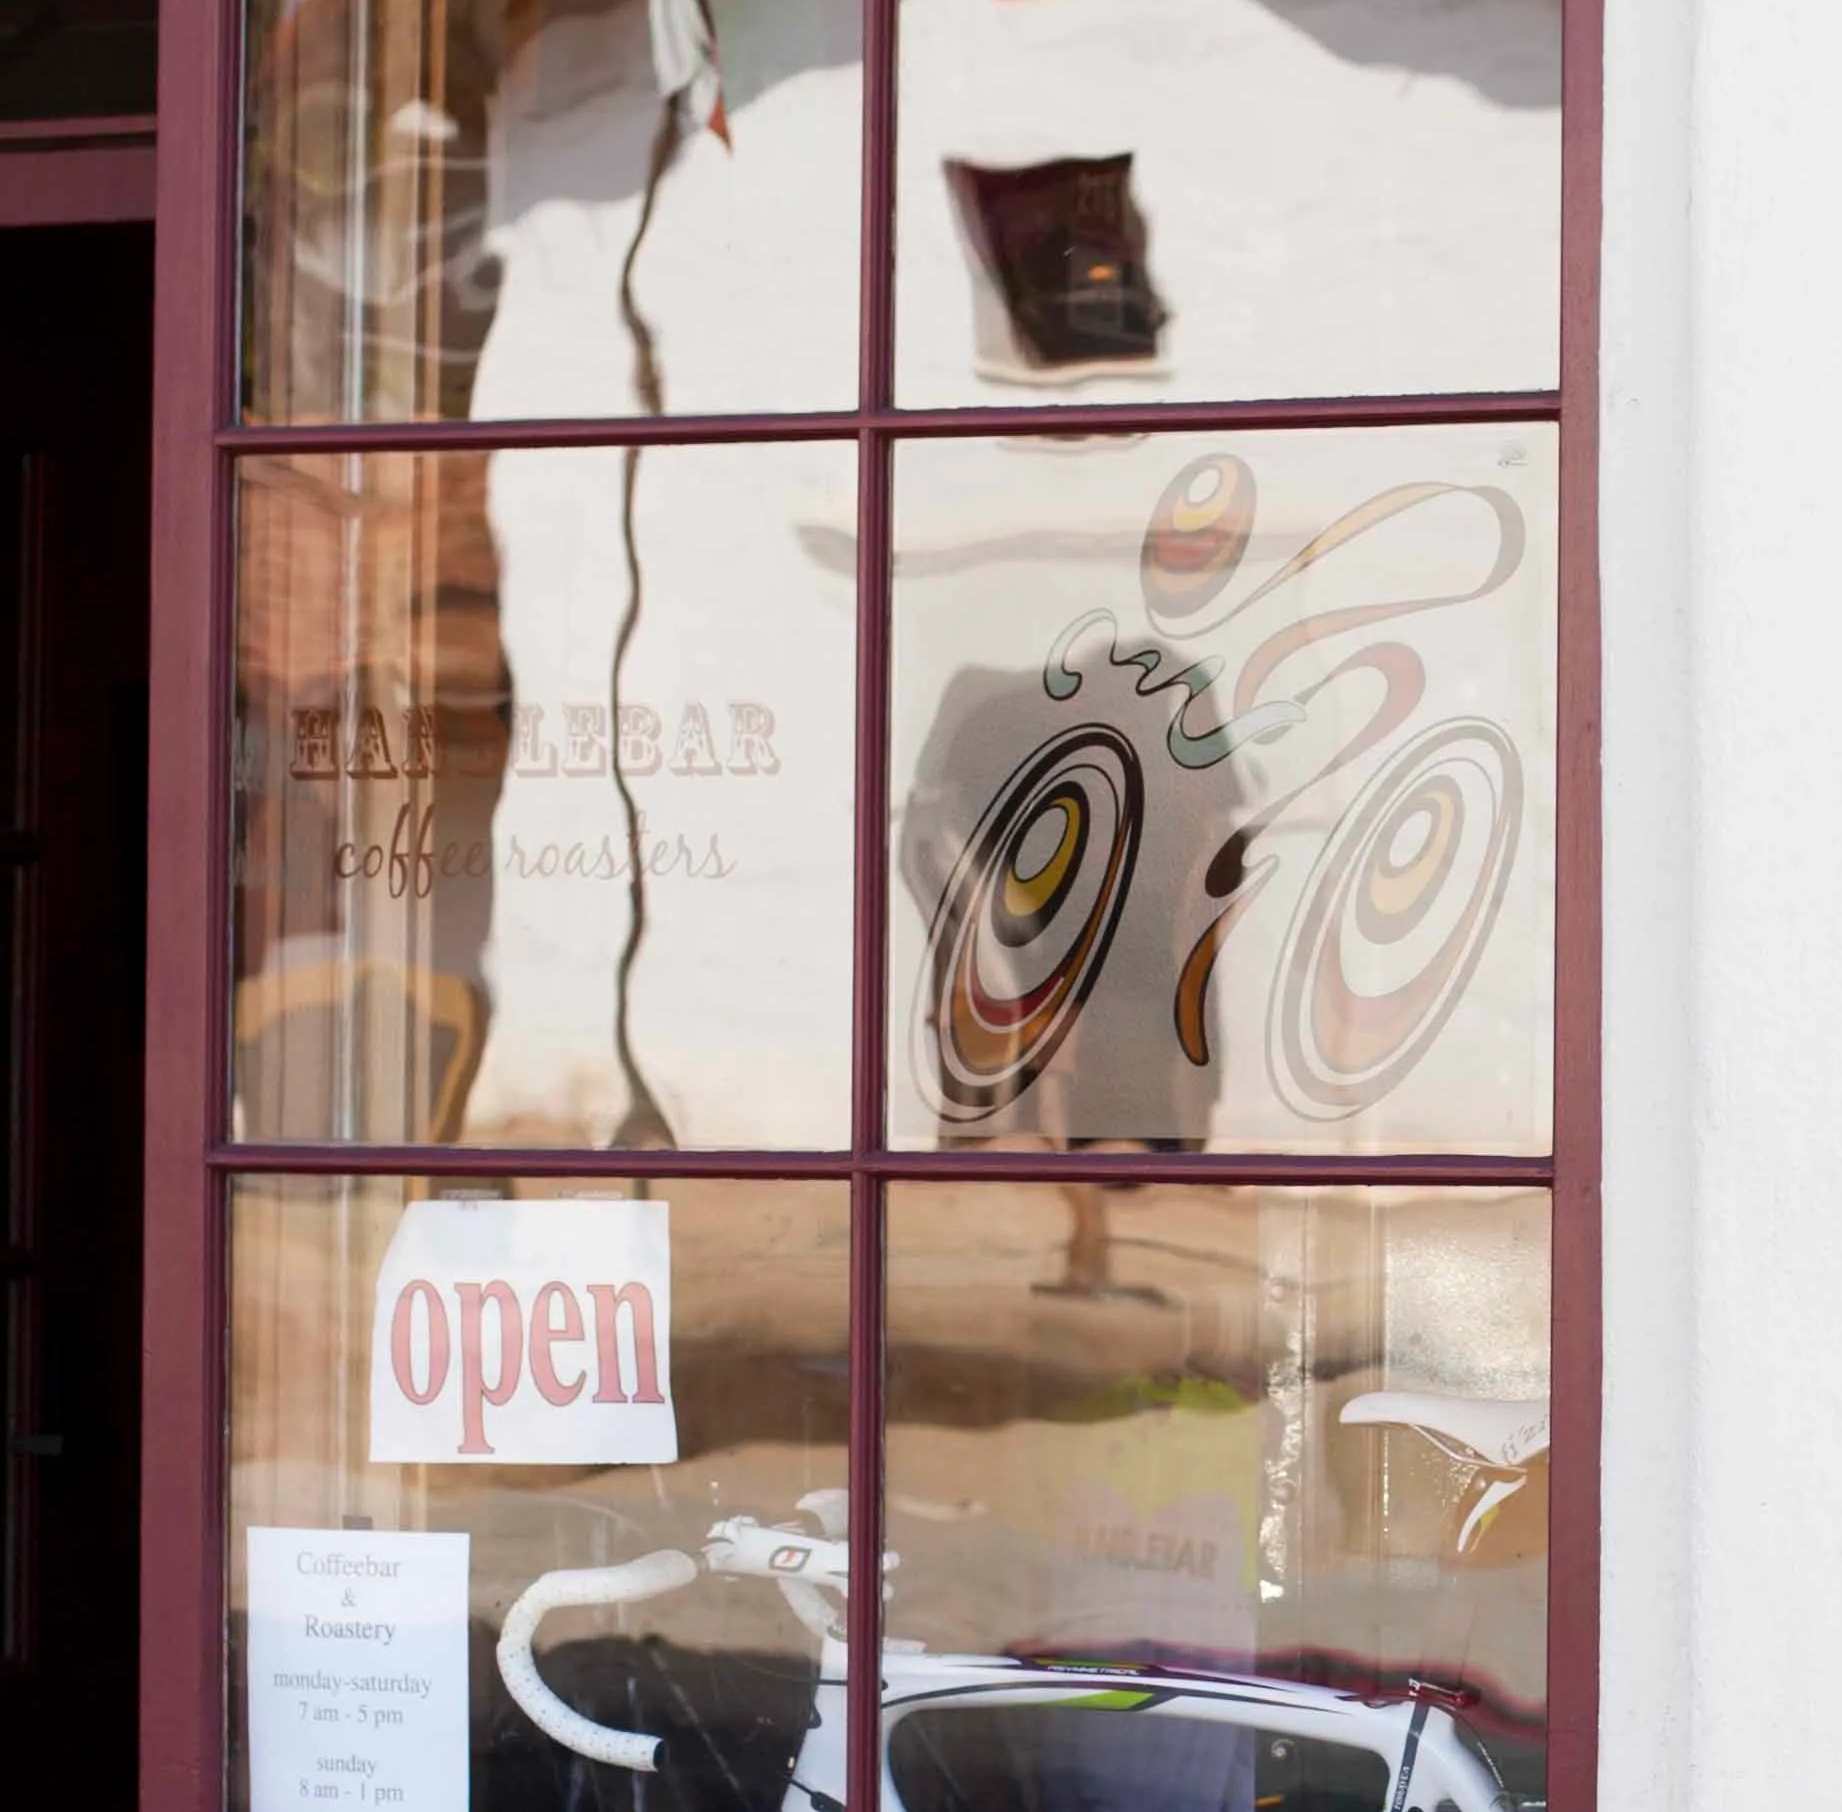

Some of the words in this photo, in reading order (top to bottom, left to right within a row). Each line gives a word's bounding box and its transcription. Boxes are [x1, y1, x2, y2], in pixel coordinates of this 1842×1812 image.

[334, 802, 491, 899] coffee
[505, 807, 736, 880] roasters
[390, 1278, 665, 1454] open
[296, 1550, 402, 1578] Coffeebar
[340, 1588, 358, 1608] &
[304, 1614, 396, 1645] Roastery
[273, 1670, 432, 1699] monday-saturday
[299, 1701, 309, 1719] 7
[313, 1706, 340, 1722] am
[357, 1704, 368, 1724] 5
[374, 1706, 404, 1728] pm
[316, 1754, 377, 1775] sunday
[299, 1779, 310, 1798] 8
[313, 1784, 340, 1800] am
[374, 1784, 404, 1806] pm
